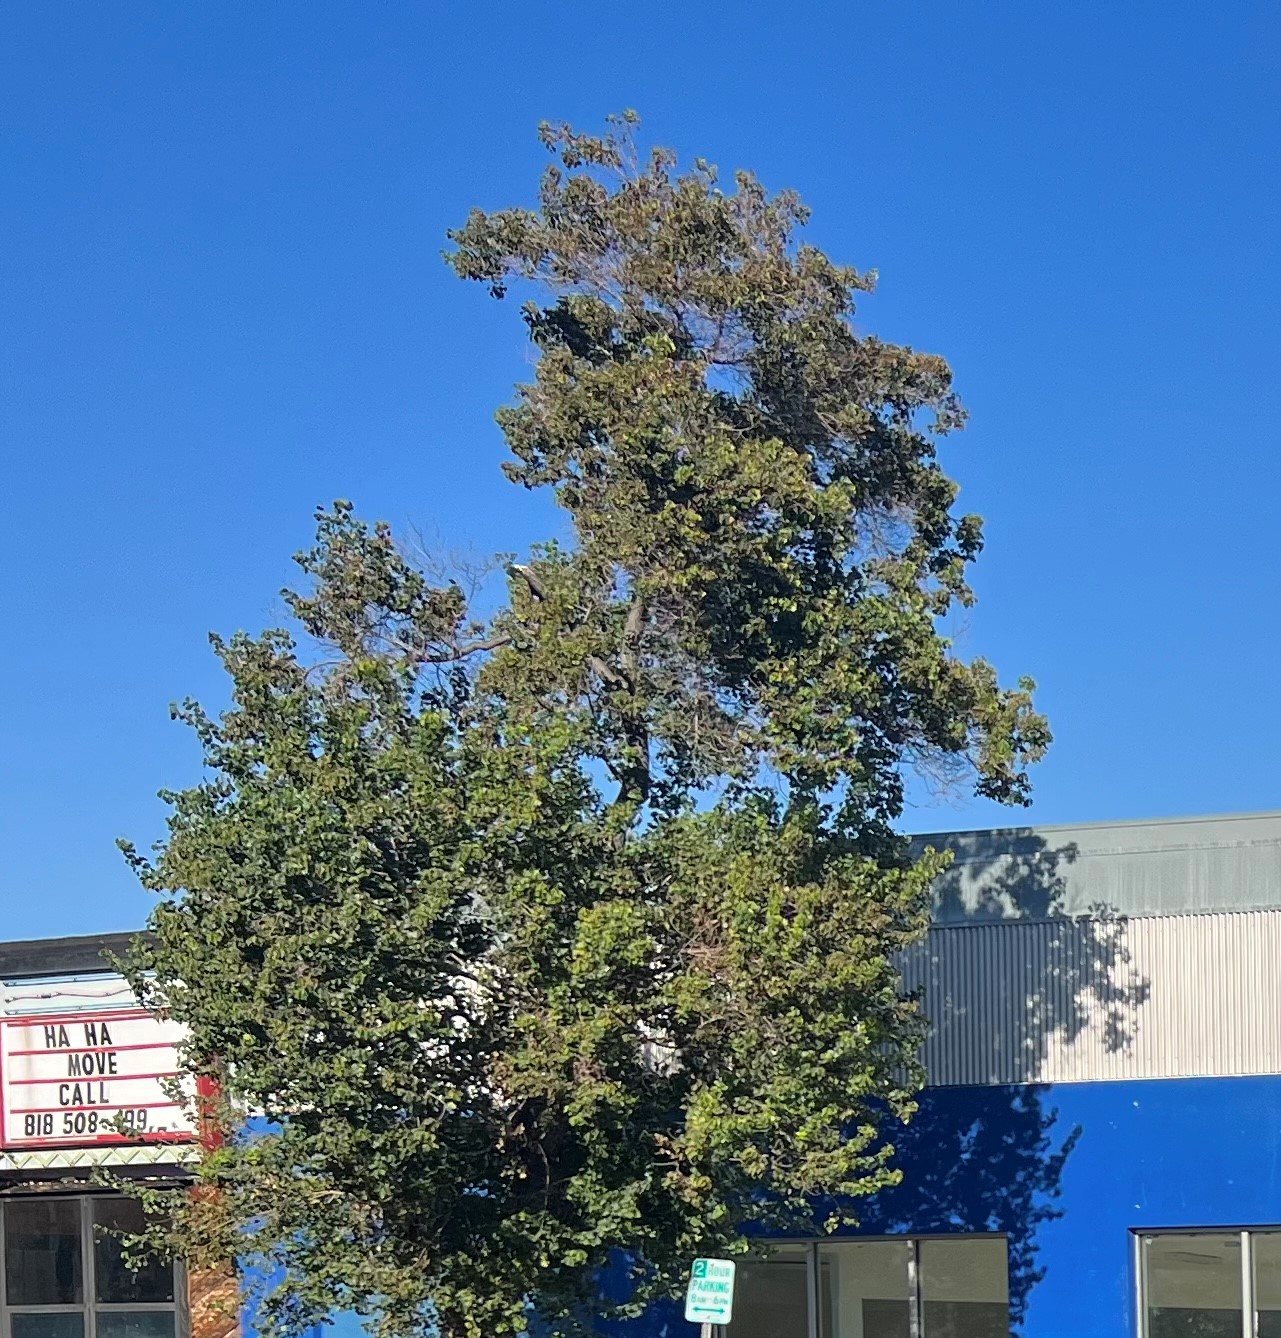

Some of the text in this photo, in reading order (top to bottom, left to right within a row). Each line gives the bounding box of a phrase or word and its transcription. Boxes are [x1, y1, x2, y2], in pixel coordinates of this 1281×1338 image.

[44, 1022, 112, 1048] HA HA
[68, 1052, 118, 1076] MOVE
[59, 1081, 109, 1106] CALL
[24, 1113, 54, 1136] 818
[695, 1262, 730, 1277] 2 HOUR
[692, 1279, 730, 1293] PARKING
